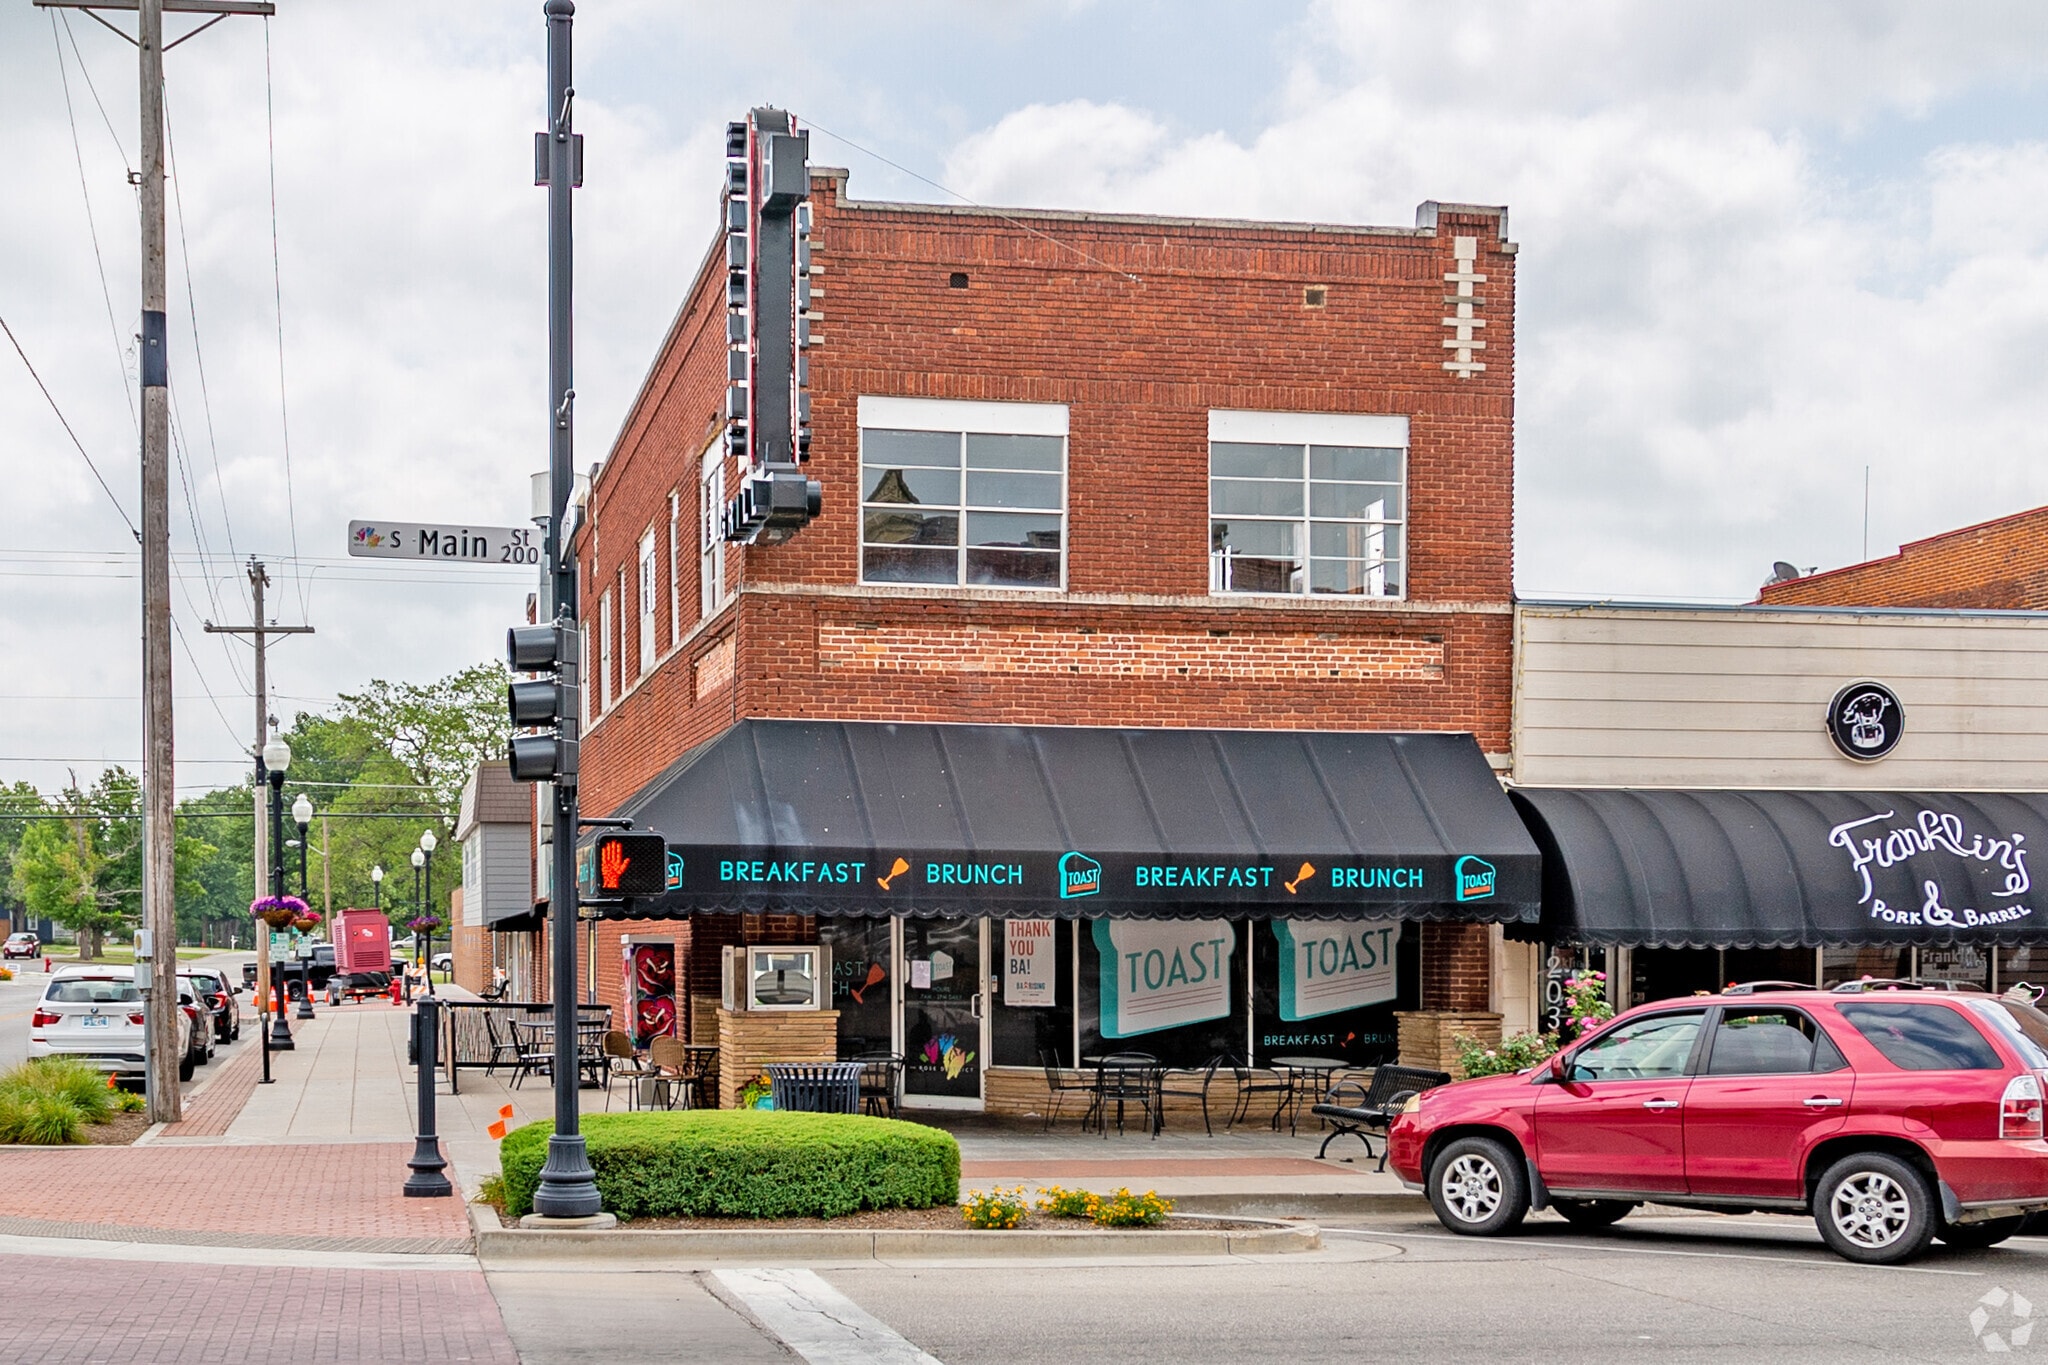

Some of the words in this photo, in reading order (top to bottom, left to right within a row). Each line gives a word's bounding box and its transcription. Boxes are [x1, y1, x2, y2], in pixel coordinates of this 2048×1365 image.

[390, 530, 401, 548] S
[418, 529, 487, 558] Main
[510, 529, 530, 547] St
[501, 546, 538, 564] 200
[720, 861, 865, 884] BREAKFAST
[926, 863, 1023, 885] BRUNCH
[1067, 868, 1098, 886] TOAST
[1136, 865, 1275, 888] BREAKFAST
[1332, 867, 1424, 889] BRUNCH
[1464, 871, 1493, 889] TOAST
[1922, 880, 1969, 928] &
[1963, 904, 2032, 927] BARREL
[1009, 921, 1050, 938] THANK
[1009, 940, 1034, 956] YOU
[1302, 927, 1394, 980] TOAST
[1010, 959, 1031, 975] BA!
[1125, 938, 1226, 993] TOAST
[1546, 955, 1562, 1030] 203
[1264, 1034, 1335, 1046] BREAKFAST
[1364, 1033, 1395, 1045] BRUN
